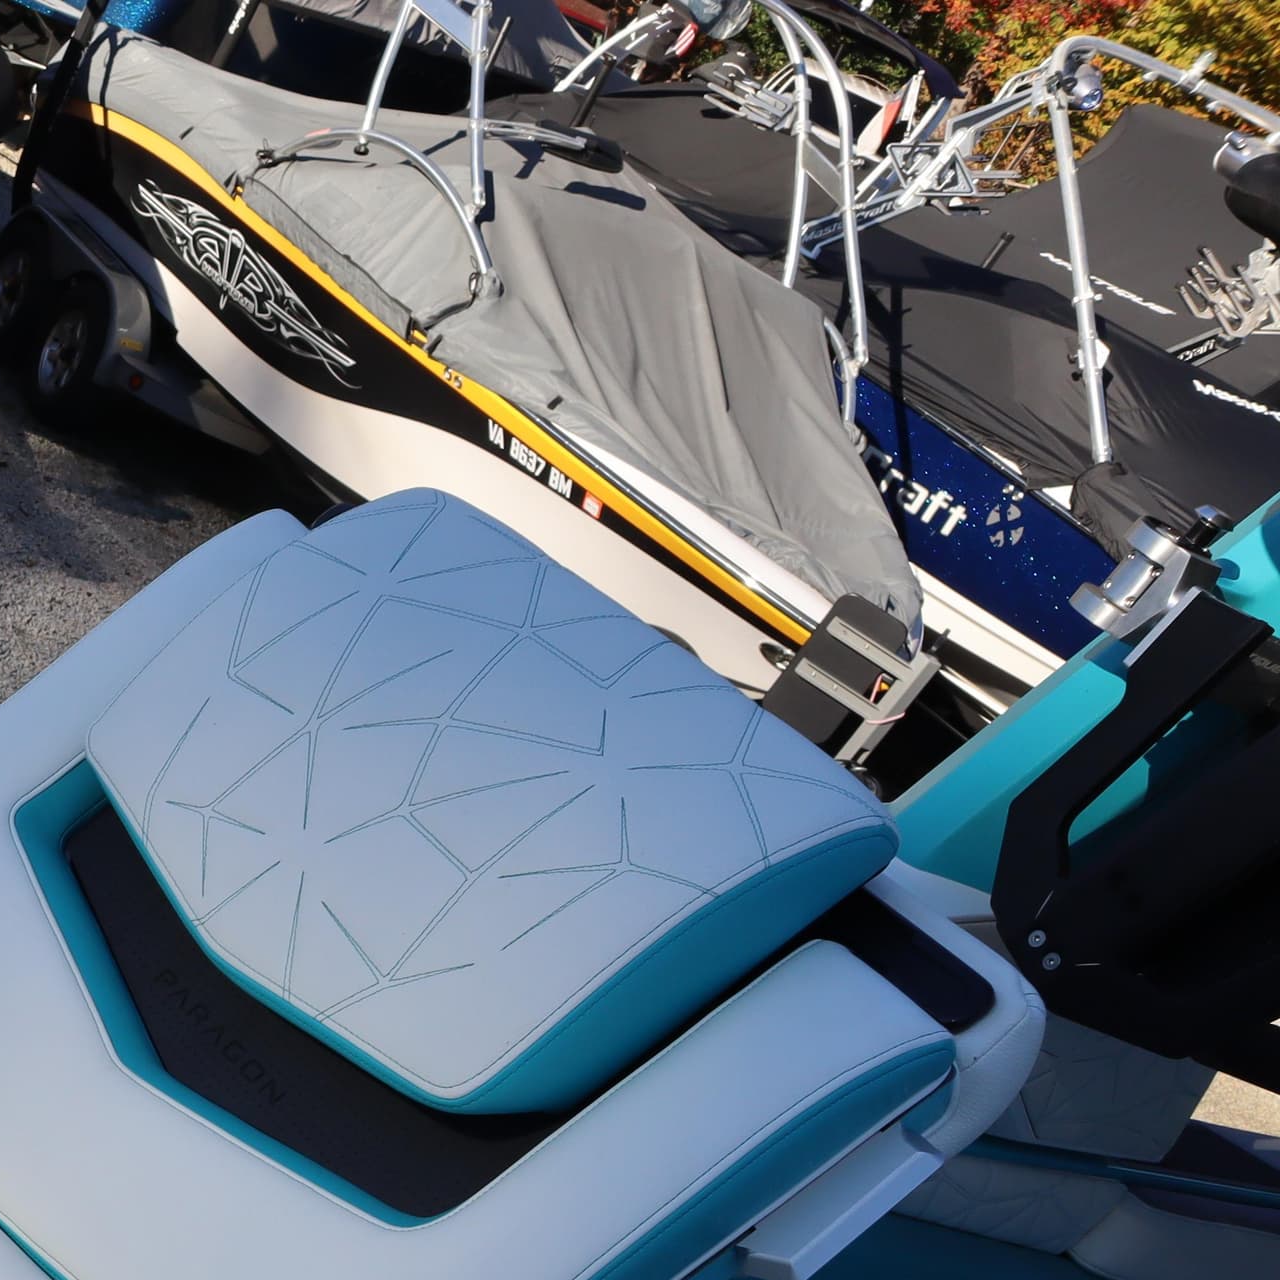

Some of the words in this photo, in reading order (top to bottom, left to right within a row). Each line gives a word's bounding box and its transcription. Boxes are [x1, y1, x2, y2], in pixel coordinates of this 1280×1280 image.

[487, 418, 505, 449] VA
[509, 436, 547, 477] 8637
[547, 466, 573, 499] BM
[154, 967, 288, 1105] PARAGON
